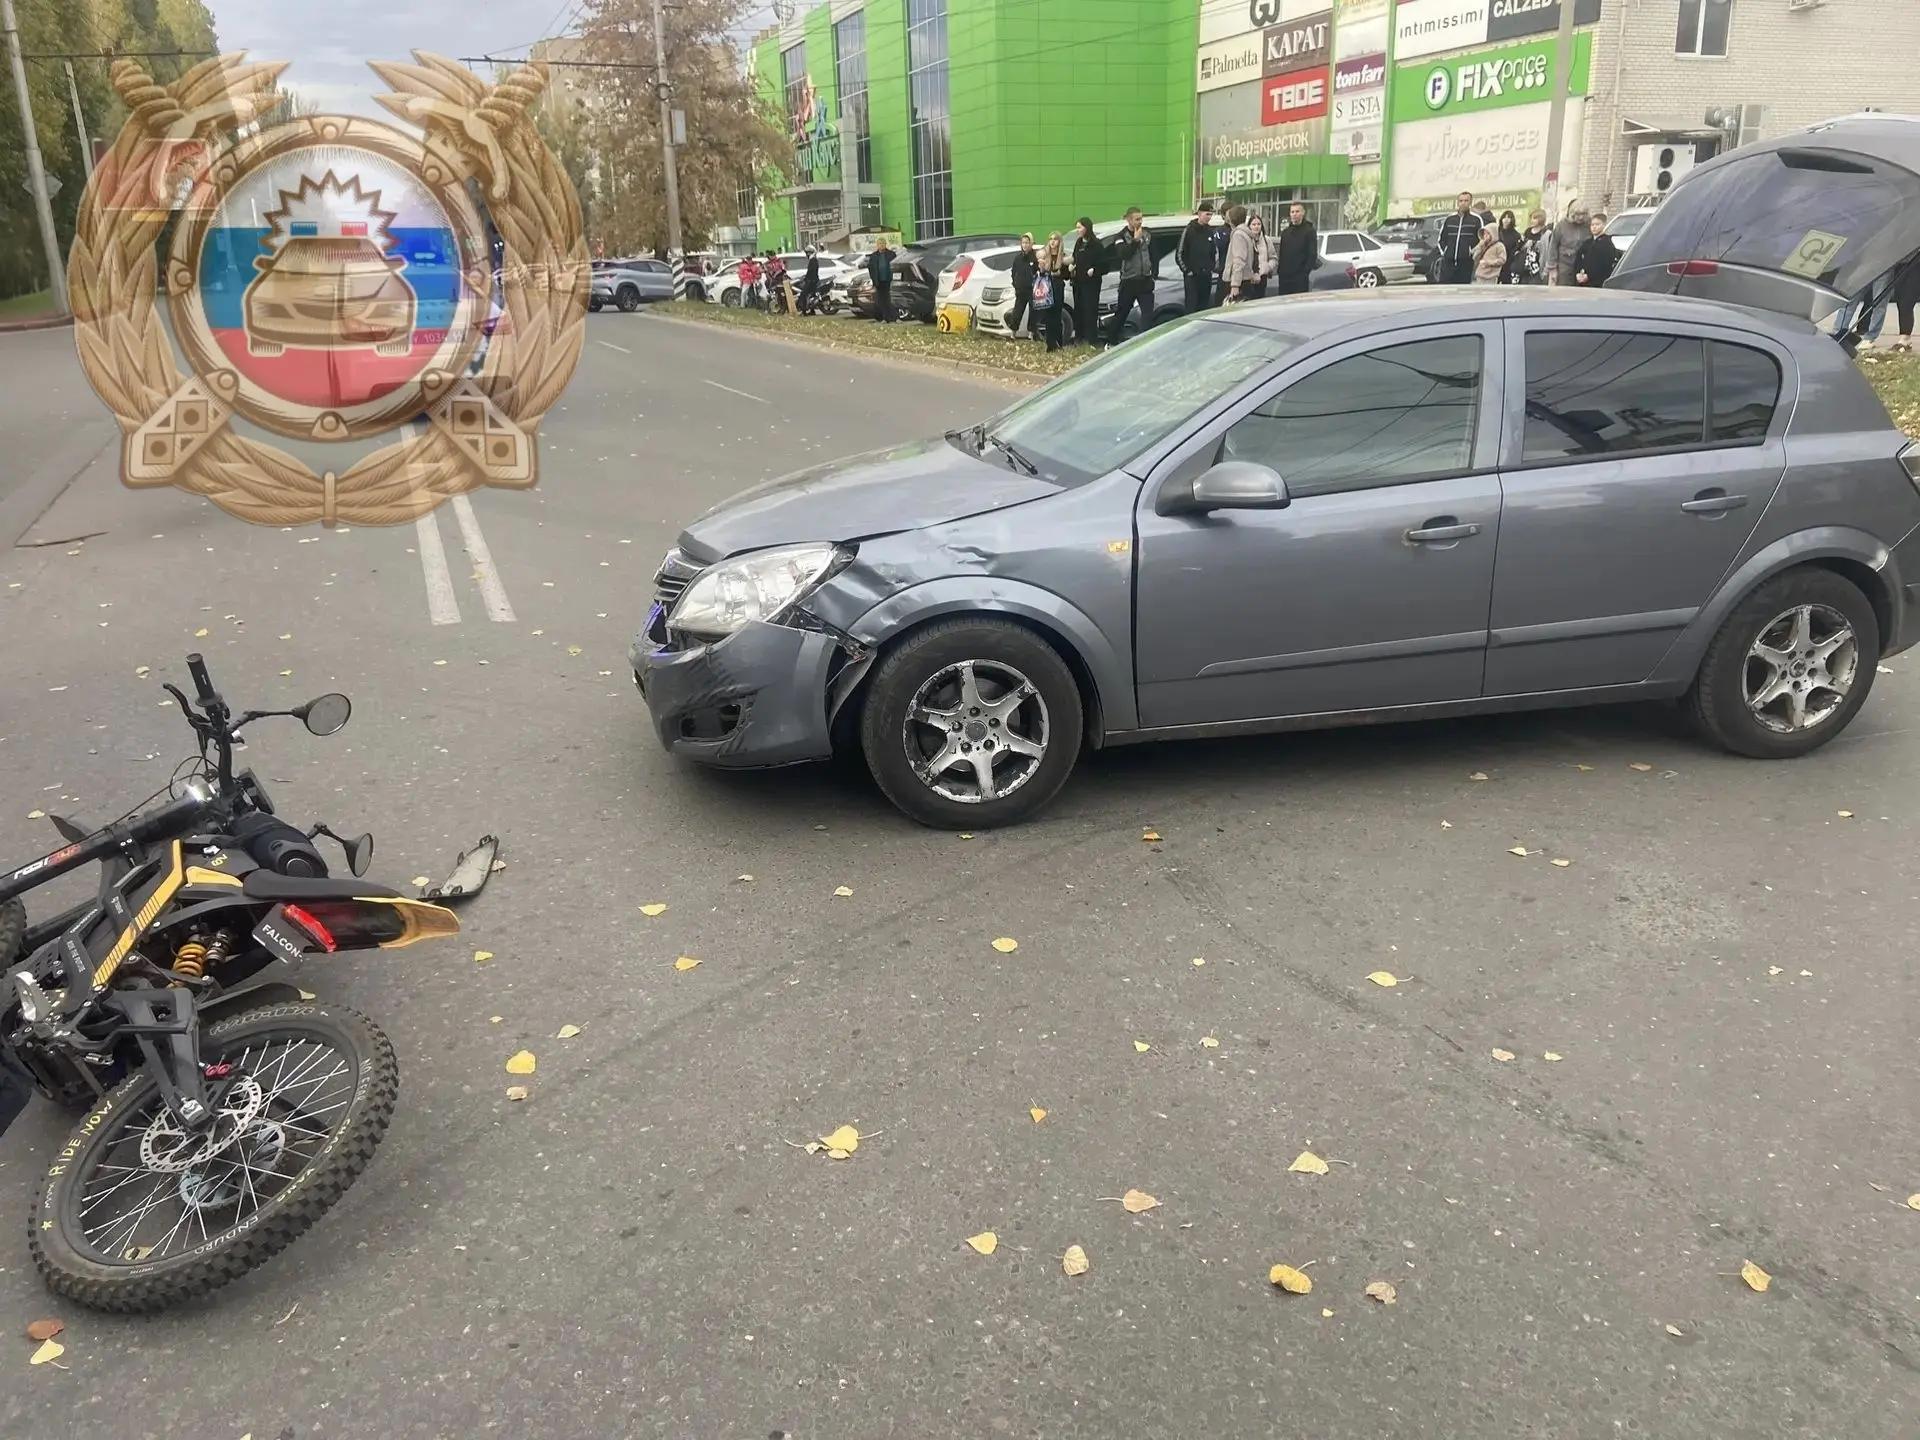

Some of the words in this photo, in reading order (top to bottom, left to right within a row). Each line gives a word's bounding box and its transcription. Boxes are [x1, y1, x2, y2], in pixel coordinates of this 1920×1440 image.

[1400, 9, 1483, 39] intimissimi
[1493, 0, 1560, 18] CALZED
[1267, 22, 1328, 61] КАРАТ
[1269, 78, 1325, 112] ТВОЕ
[1456, 59, 1504, 102] FIX
[1501, 54, 1547, 83] price
[1232, 131, 1310, 160] Перекресток
[1475, 129, 1540, 156] ОБОЕВ
[1216, 163, 1267, 190] ЦВЕТЫ
[262, 924, 302, 959] FALCON
[48, 1138, 82, 1177] RIDE
[80, 1100, 113, 1136] NOW
[194, 1215, 259, 1255] ENDURO
